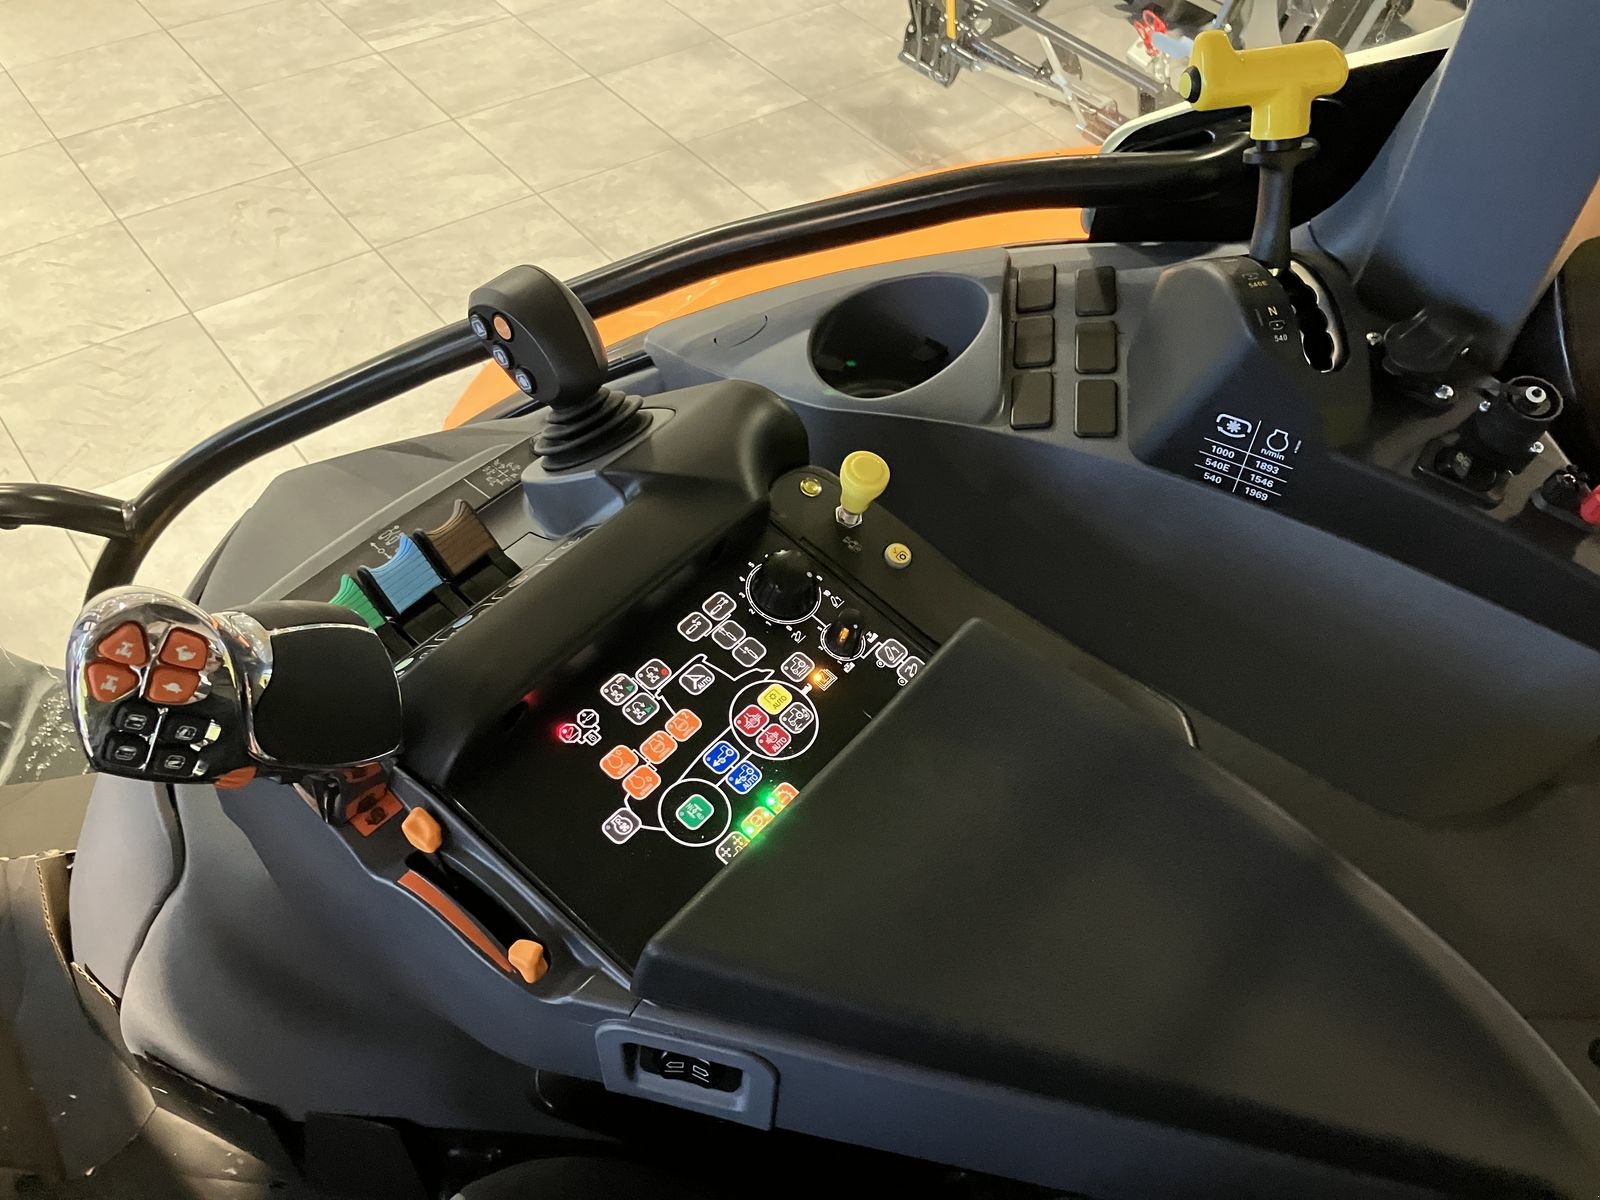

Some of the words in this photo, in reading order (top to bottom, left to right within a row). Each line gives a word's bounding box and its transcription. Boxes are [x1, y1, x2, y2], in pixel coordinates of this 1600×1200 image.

[1267, 306, 1278, 316] N
[1274, 334, 1288, 342] 540
[1211, 445, 1235, 458] 1000
[1260, 448, 1285, 460] n/min
[1205, 458, 1231, 472] 540E
[1255, 460, 1279, 475] 1893
[1203, 472, 1222, 484] 540
[1250, 473, 1274, 488] 1546
[1245, 487, 1268, 501] 1969
[698, 676, 712, 690] AUTO
[773, 695, 787, 709] AUTO
[772, 737, 787, 752] AUTO
[742, 775, 759, 790] AUTO
